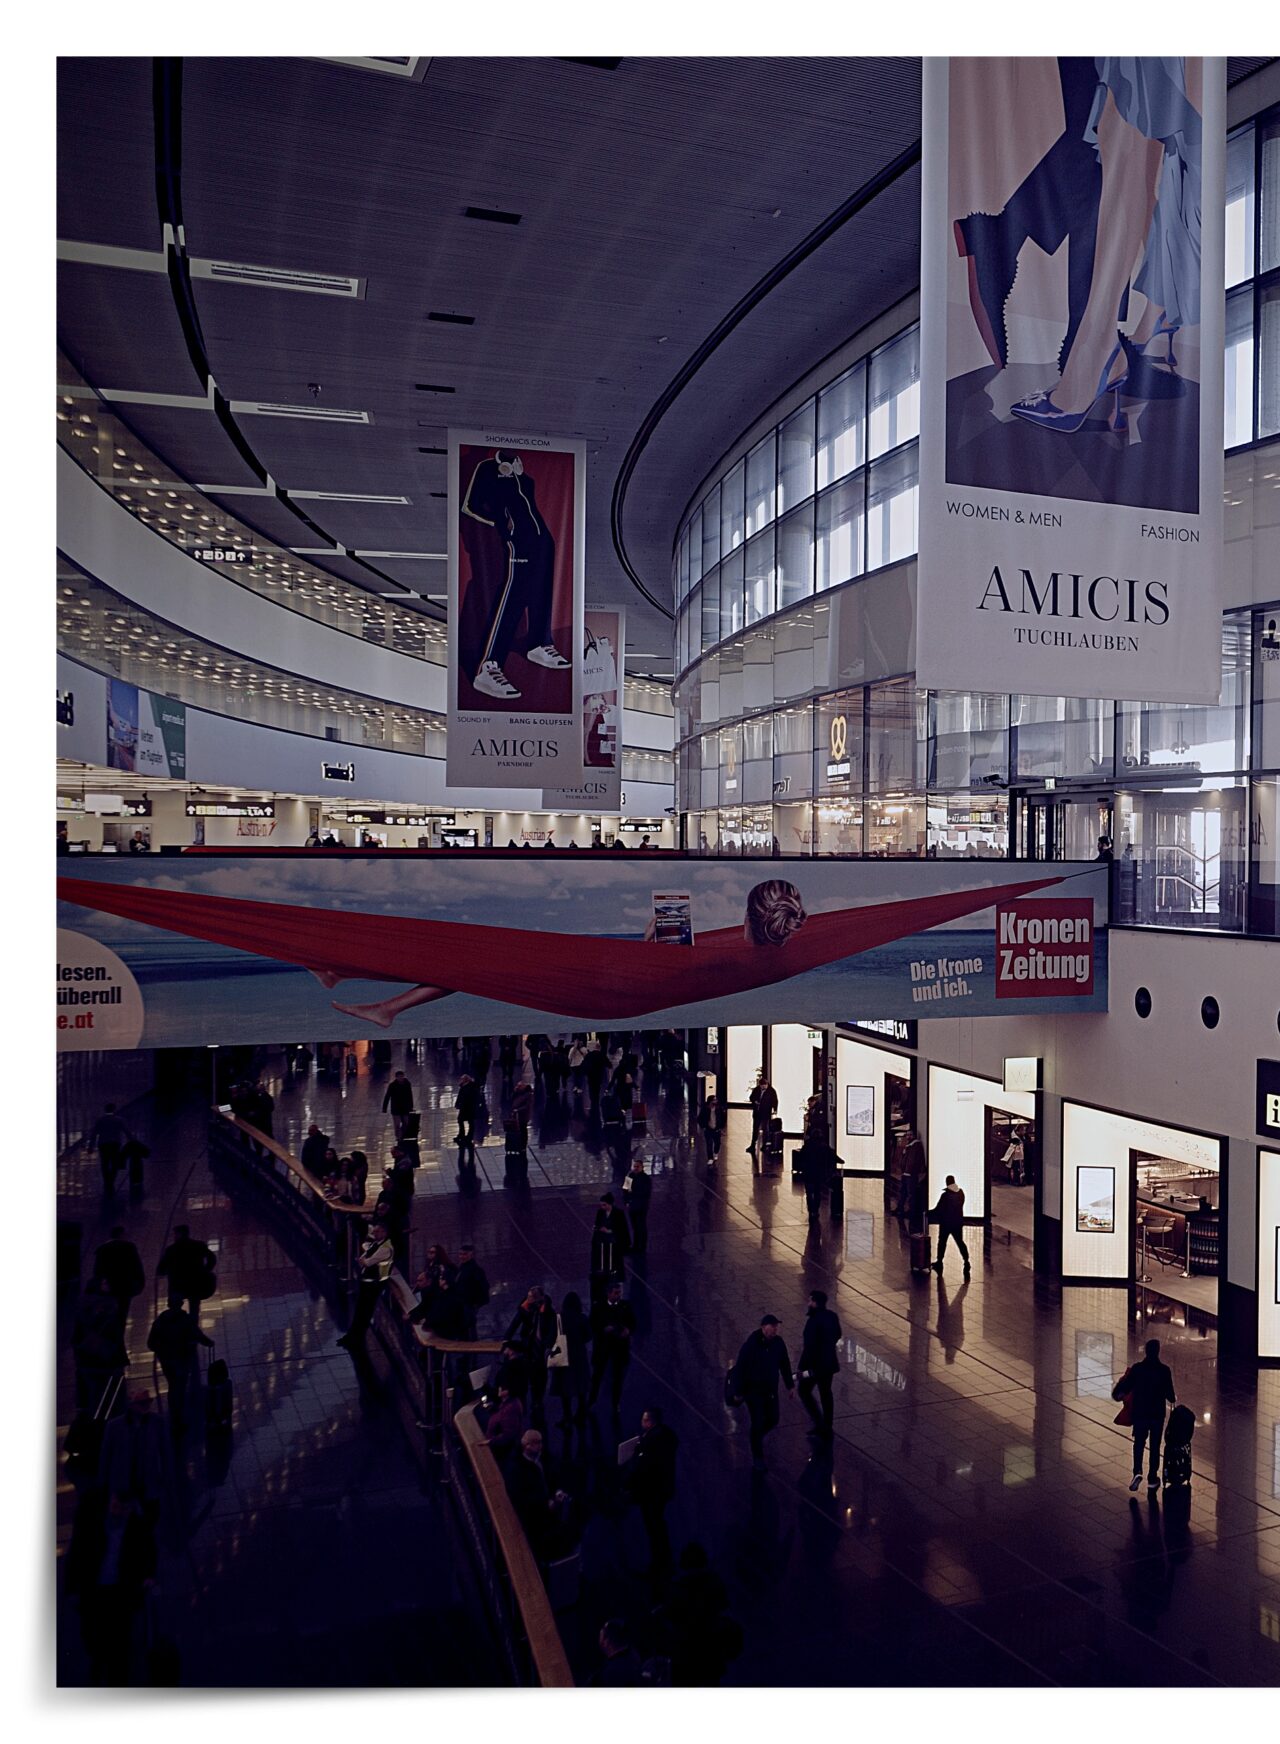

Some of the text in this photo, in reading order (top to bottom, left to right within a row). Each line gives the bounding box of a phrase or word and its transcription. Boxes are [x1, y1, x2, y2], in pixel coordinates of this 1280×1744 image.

[485, 435, 550, 447] SHOPAMICIS.COM
[946, 500, 1062, 528] WOMEN & MEN
[1141, 524, 1200, 543] FASHION
[976, 565, 1170, 626] AMICIS
[1013, 627, 1140, 652] TUCHLAUBEN
[457, 715, 491, 724] SOUND BY
[509, 717, 531, 725] BANG
[539, 718, 573, 727] OLUFSEN
[471, 738, 559, 758] AMICIS
[520, 827, 546, 841] Austrian
[1000, 912, 1090, 944] Kronen
[57, 964, 112, 981] lesen.
[910, 957, 983, 982] Die Krone
[1000, 947, 1090, 983] Zeitung
[57, 986, 122, 1006] überall
[912, 978, 972, 1002] und ich.
[57, 1011, 94, 1030] e.at
